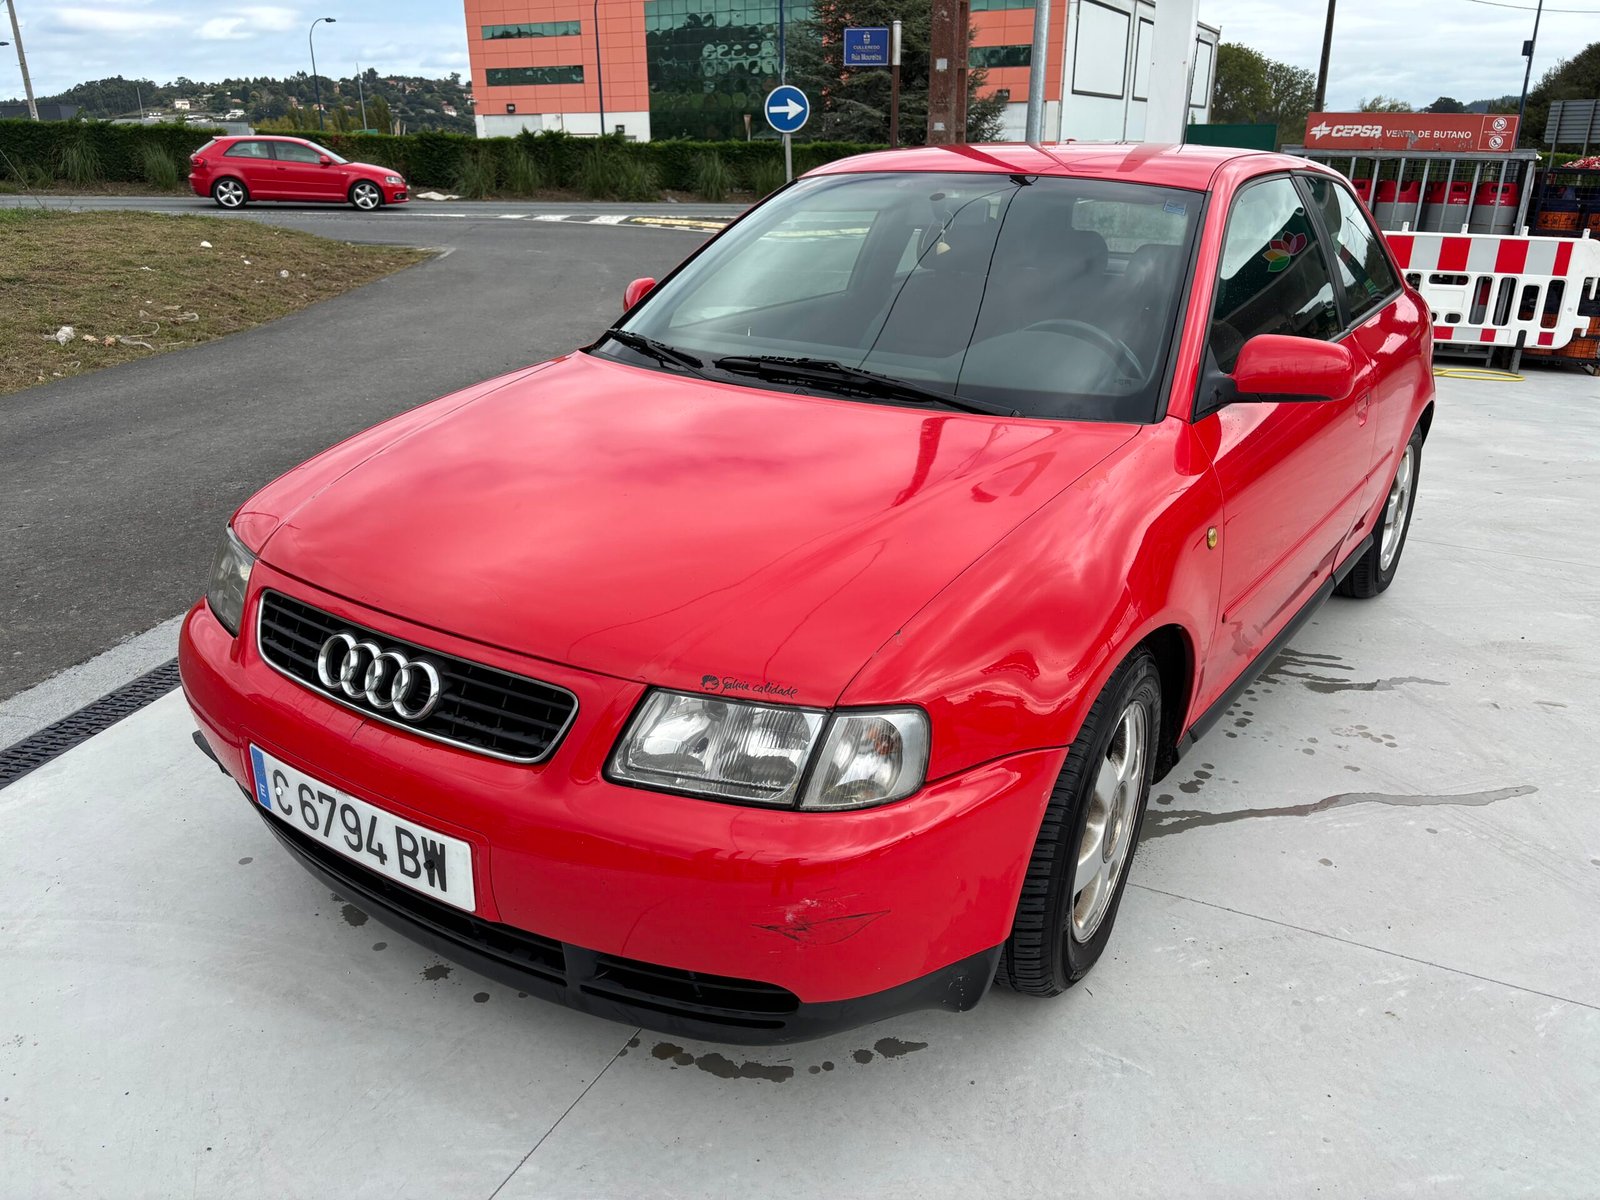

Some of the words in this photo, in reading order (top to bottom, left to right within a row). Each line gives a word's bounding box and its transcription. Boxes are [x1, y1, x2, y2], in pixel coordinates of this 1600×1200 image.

[1331, 125, 1383, 139] CEPSA
[1417, 130, 1432, 138] DE
[1433, 131, 1472, 139] BUTANO
[752, 682, 799, 699] calidade
[260, 784, 267, 798] E
[272, 769, 293, 816] C
[298, 783, 388, 866] 6794
[395, 825, 448, 893] BW
